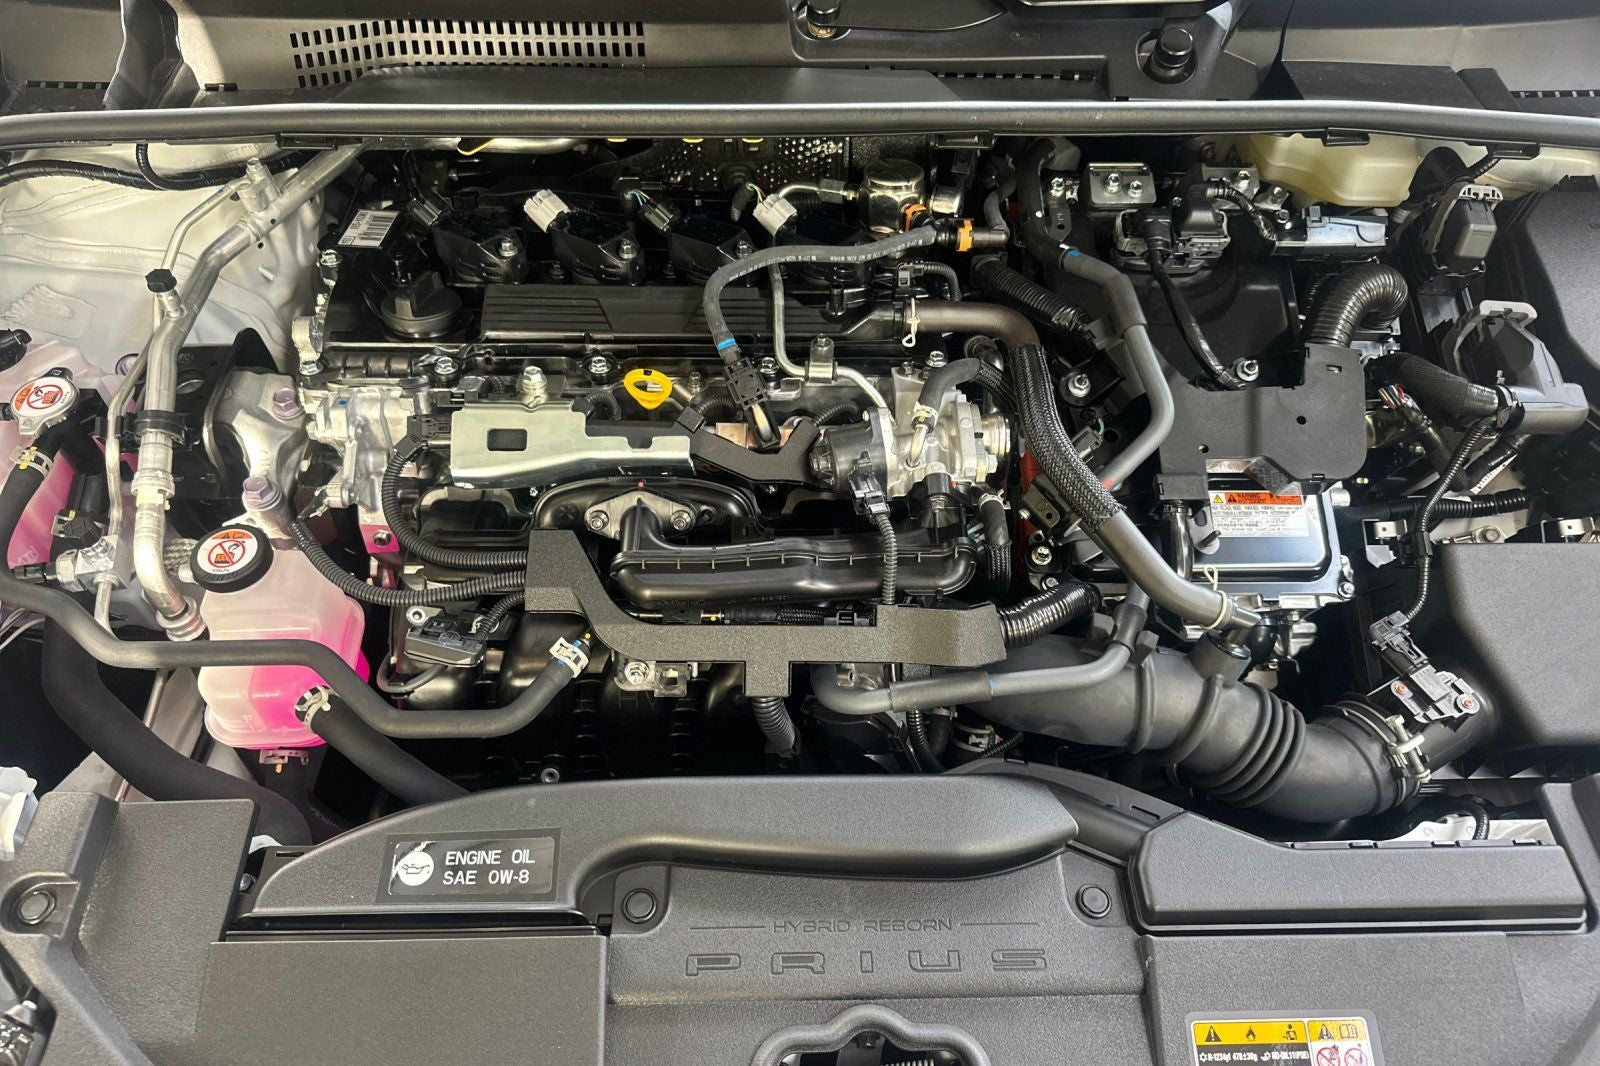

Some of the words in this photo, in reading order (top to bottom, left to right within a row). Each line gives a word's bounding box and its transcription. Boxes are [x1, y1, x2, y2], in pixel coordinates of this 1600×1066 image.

[445, 850, 502, 866] ENGINE
[511, 849, 536, 864] OIL
[442, 870, 478, 885] SAE
[773, 920, 851, 934] HYBRID
[863, 918, 953, 933] REBORN
[685, 948, 1047, 977] PRIUS
